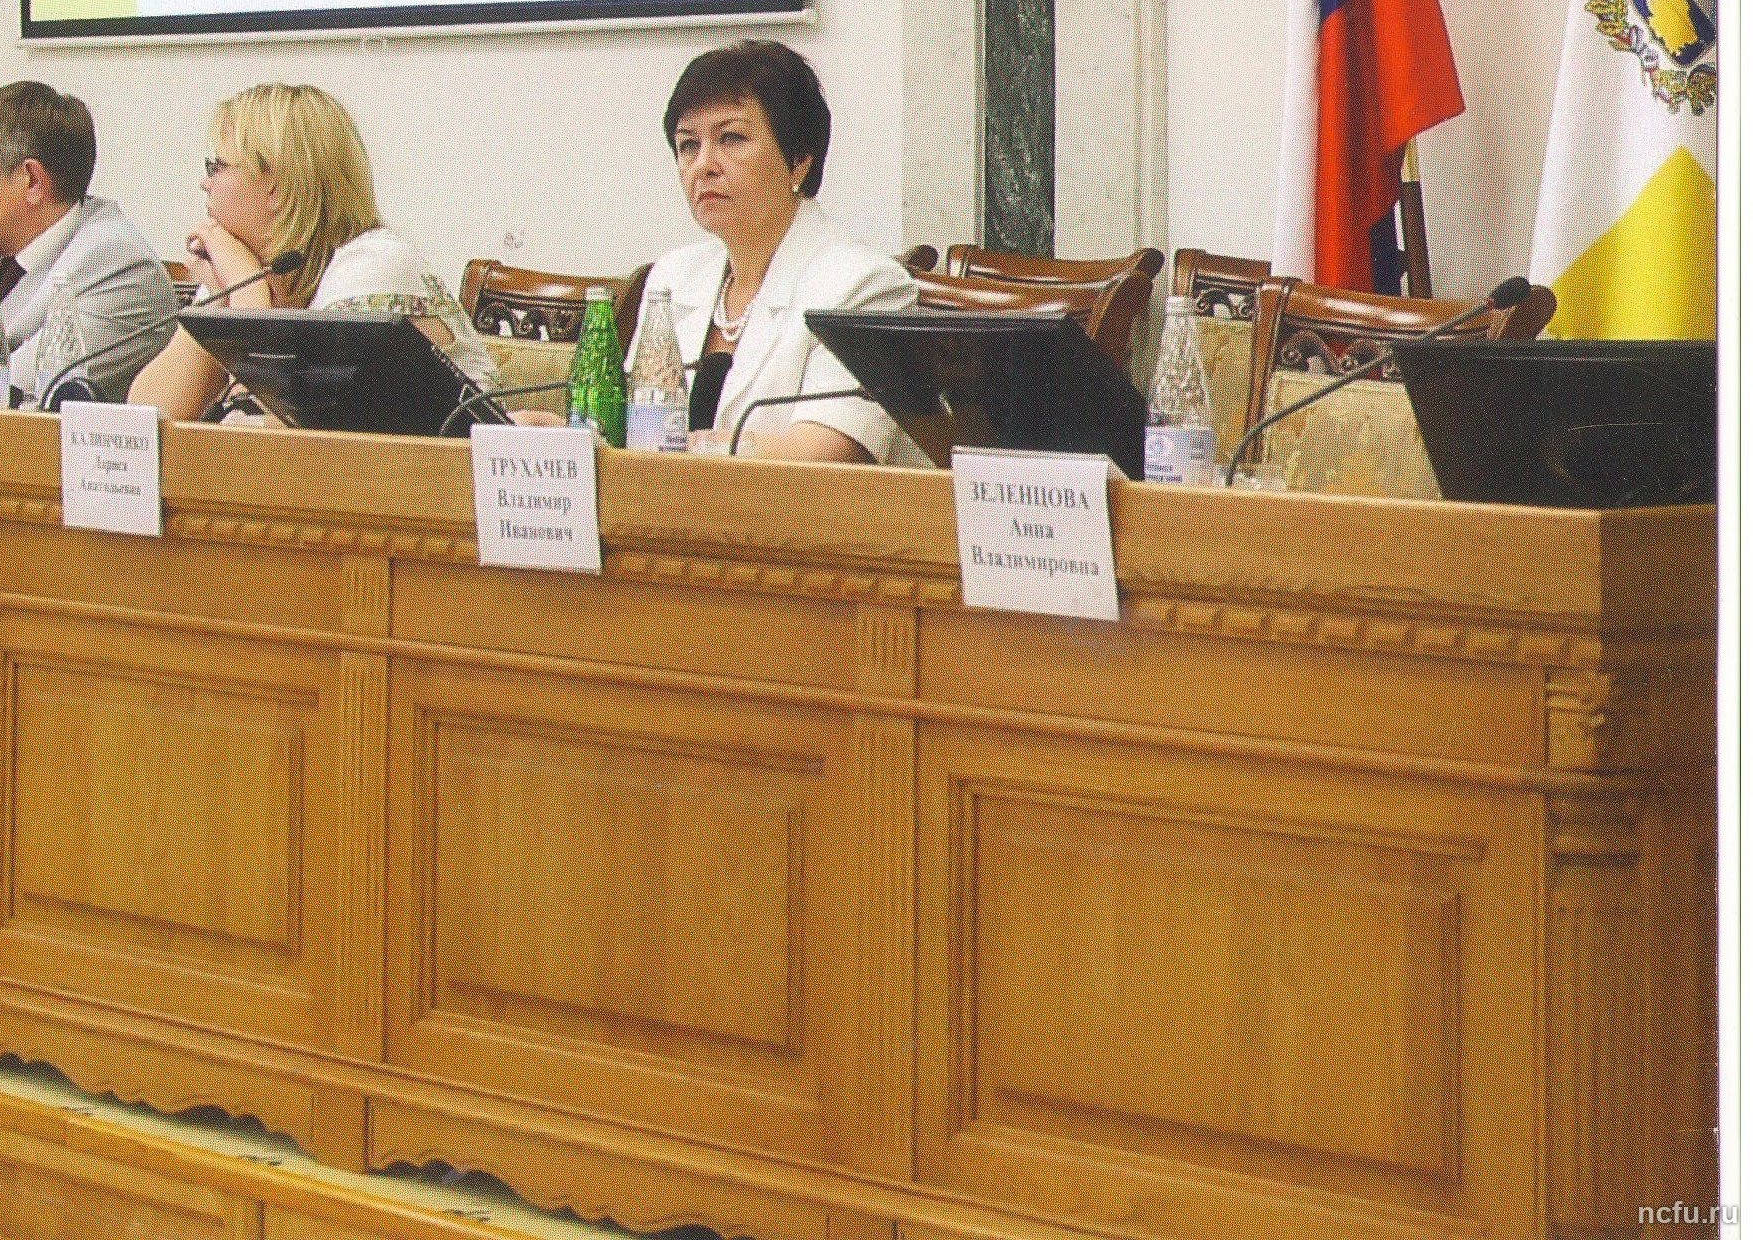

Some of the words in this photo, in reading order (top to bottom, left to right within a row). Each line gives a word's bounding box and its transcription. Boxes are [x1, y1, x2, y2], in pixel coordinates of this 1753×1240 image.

[70, 431, 149, 451] КАЛИНЧЕНКО
[489, 457, 578, 479] ТРУХАЧЕВ
[497, 488, 572, 515] Владимир
[971, 480, 1090, 510] ЗЕЛЕНЦОВА
[499, 519, 573, 542] Иванович
[1009, 518, 1054, 539] Анна
[970, 545, 1099, 577] Владимировна
